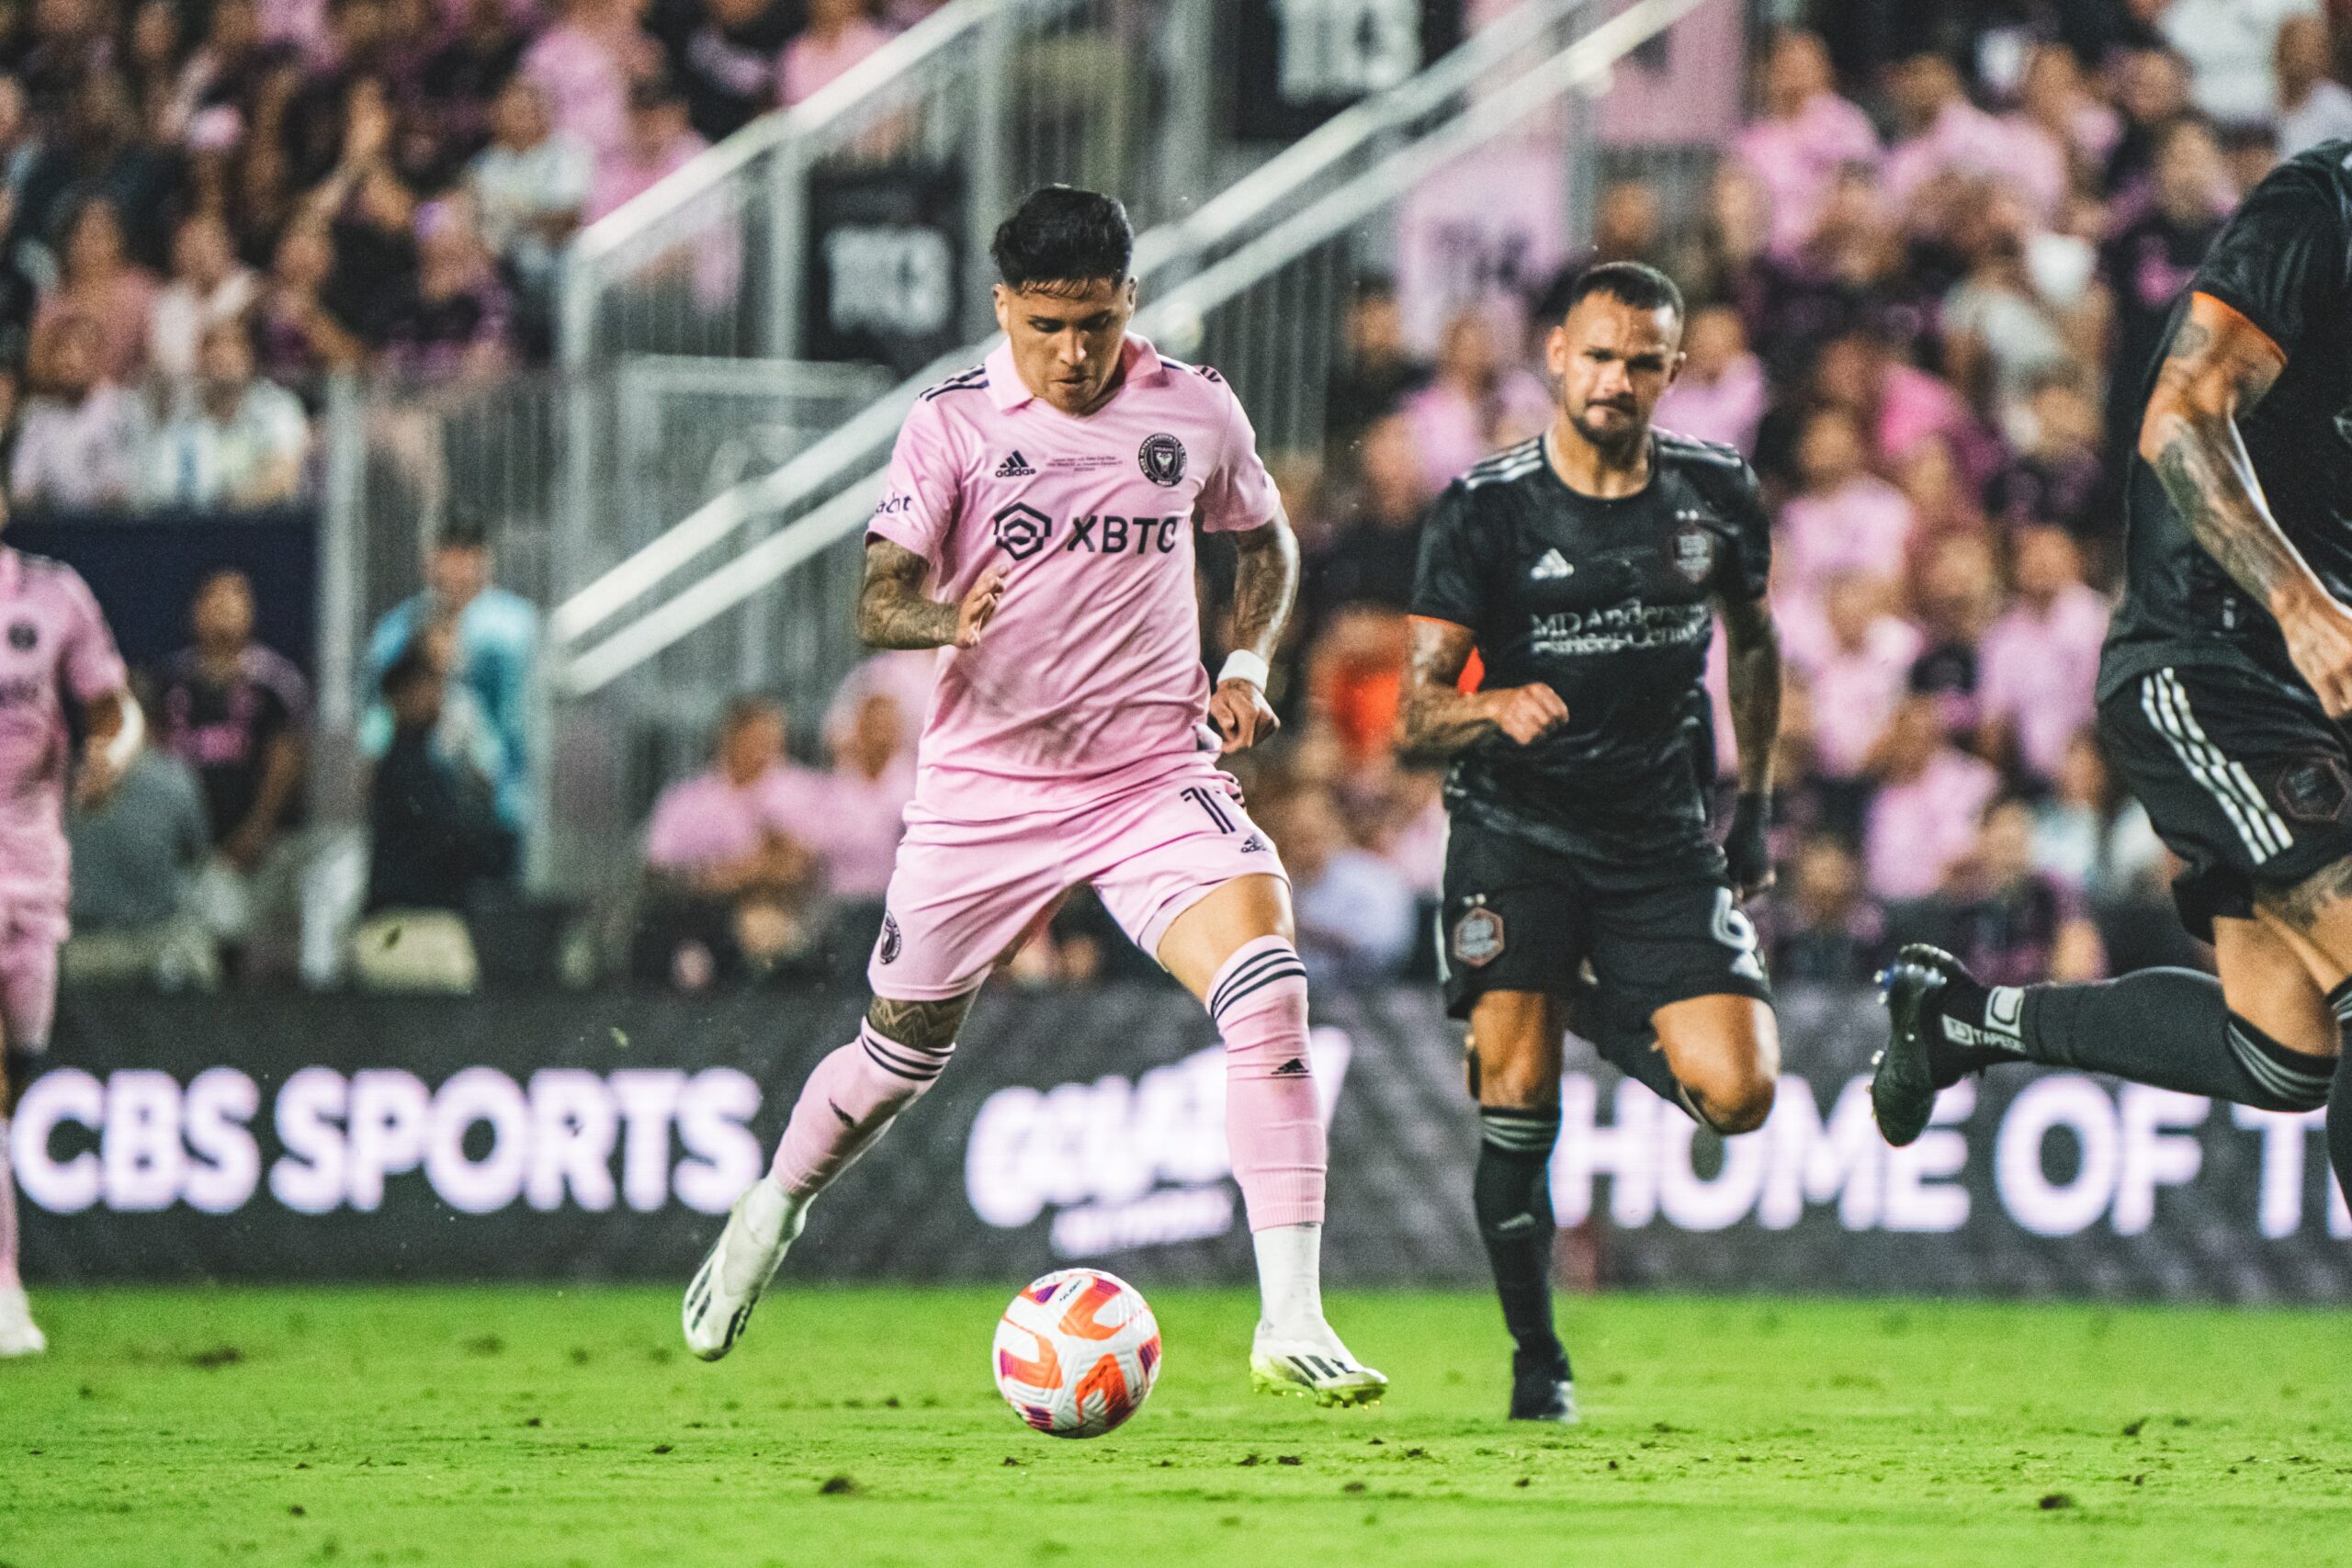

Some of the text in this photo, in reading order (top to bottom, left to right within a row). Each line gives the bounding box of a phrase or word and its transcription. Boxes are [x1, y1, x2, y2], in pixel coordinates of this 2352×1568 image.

[995, 468, 1036, 478] adidas
[1067, 515, 1177, 554] XBTC
[10, 1066, 763, 1214] CBS SPORTS
[1547, 1073, 2352, 1239] HOME OF T
